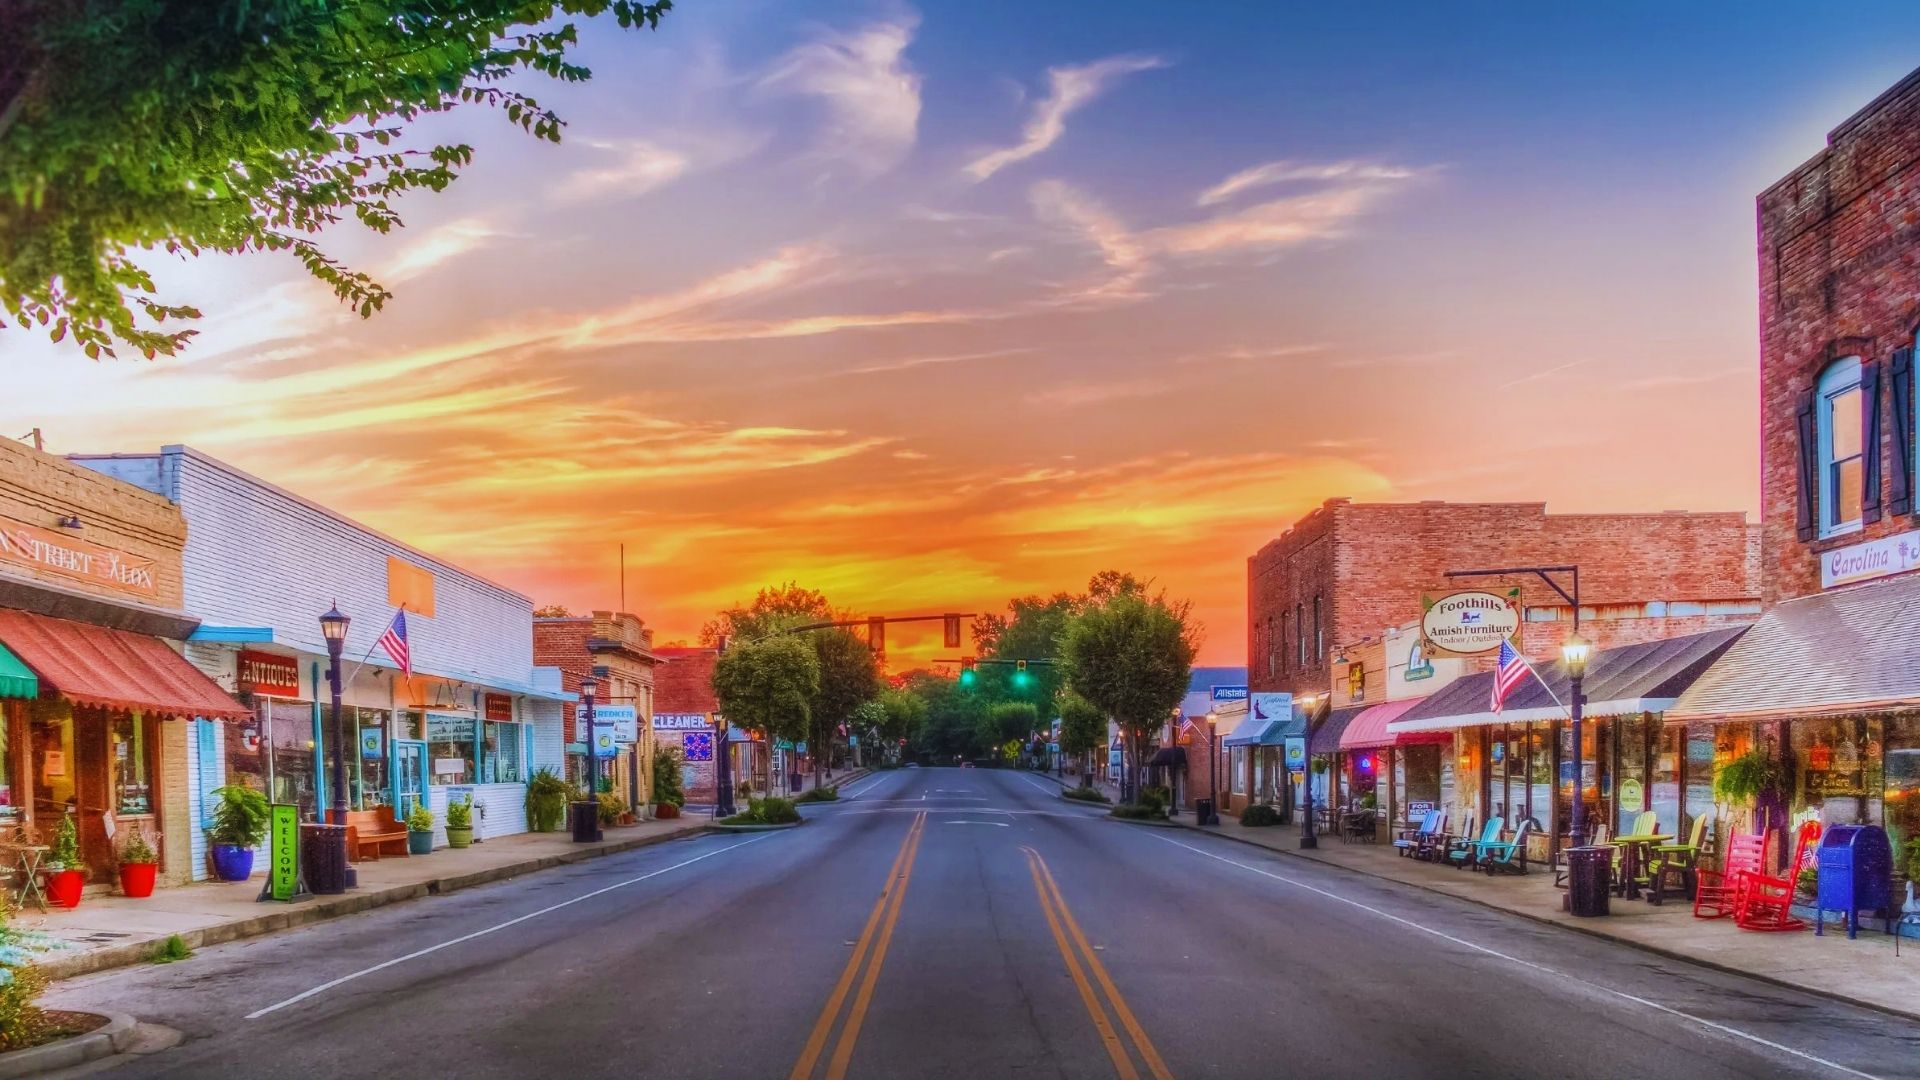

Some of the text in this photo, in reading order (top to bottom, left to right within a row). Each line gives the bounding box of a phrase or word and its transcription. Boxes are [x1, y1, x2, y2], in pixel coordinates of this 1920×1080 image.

[1831, 548, 1889, 577] Carolina
[1439, 598, 1502, 614] Foothills
[1430, 624, 1512, 637] Amish Furniture
[1440, 636, 1466, 644] Indoor
[242, 660, 298, 688] ANTIQUES
[1215, 689, 1247, 699] Allstate
[598, 710, 633, 719] REDKEN
[653, 715, 712, 729] CLEANER
[280, 815, 292, 885] WELCOME
